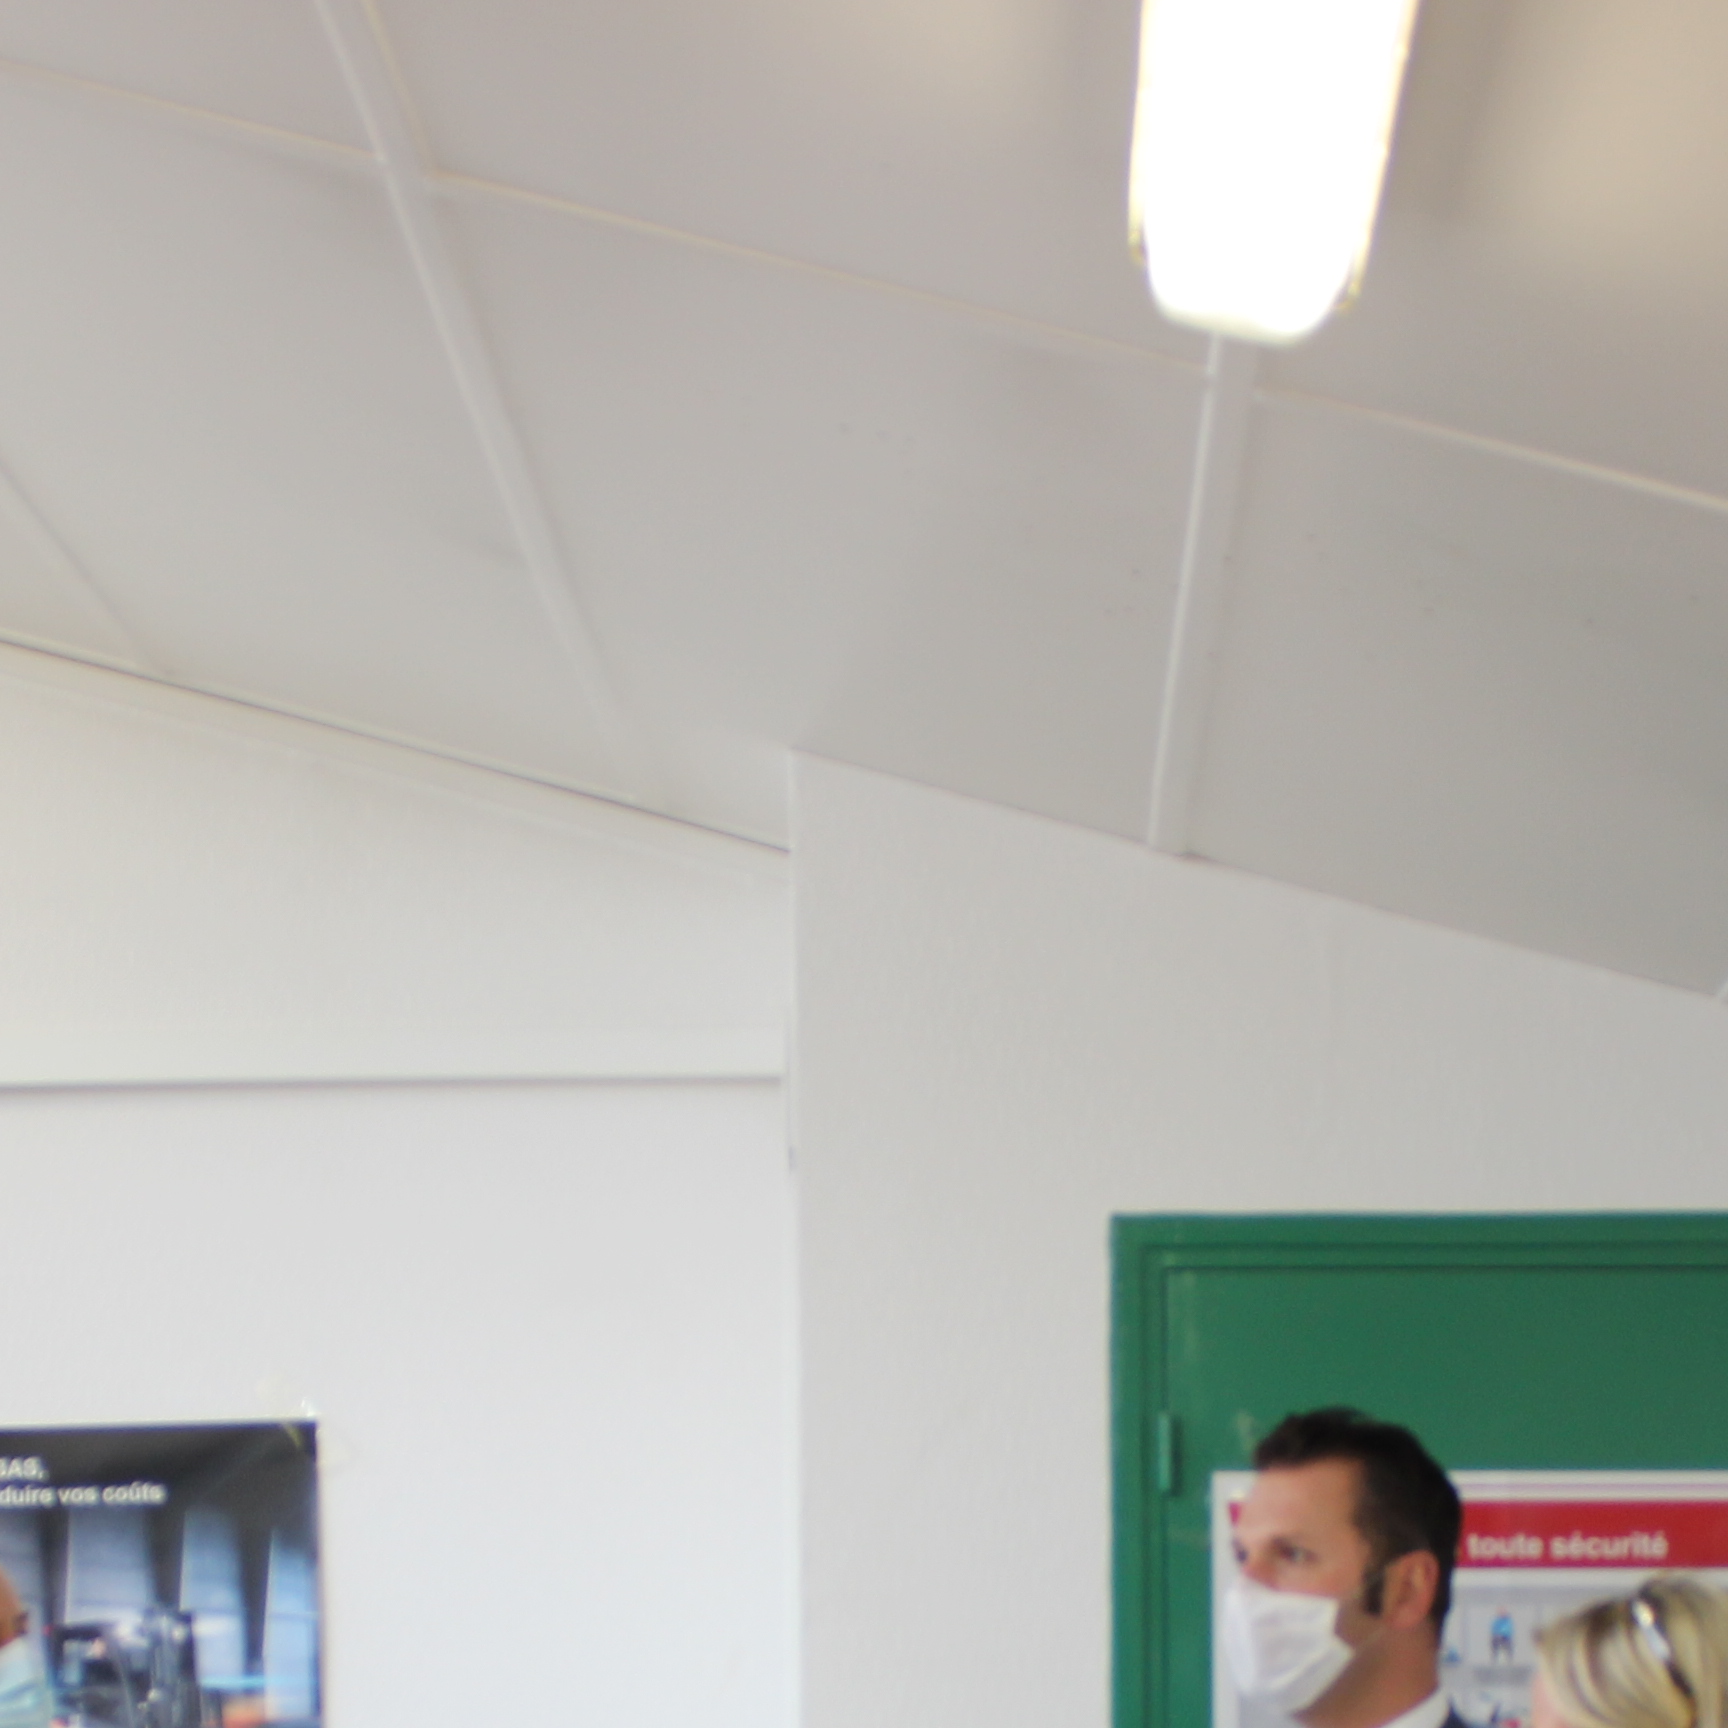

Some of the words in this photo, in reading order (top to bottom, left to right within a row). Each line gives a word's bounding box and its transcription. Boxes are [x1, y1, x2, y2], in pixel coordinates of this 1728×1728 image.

[57, 1486, 100, 1507] vos
[102, 1480, 166, 1505] coûts
[1467, 1532, 1544, 1561] toute
[1548, 1530, 1670, 1561] sécurité
